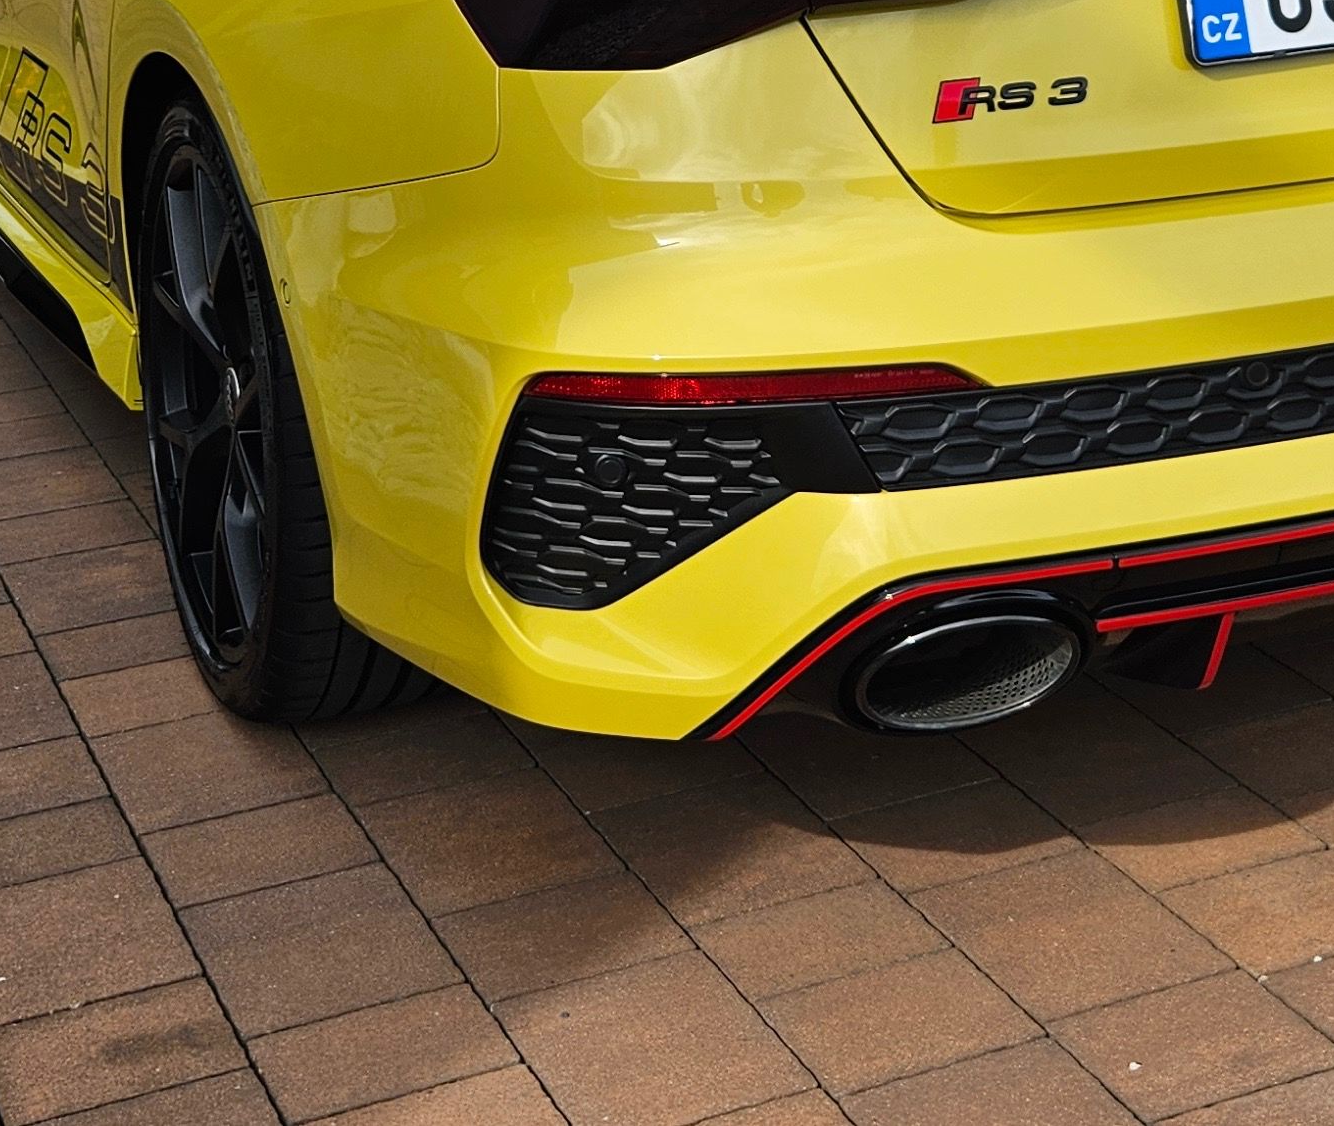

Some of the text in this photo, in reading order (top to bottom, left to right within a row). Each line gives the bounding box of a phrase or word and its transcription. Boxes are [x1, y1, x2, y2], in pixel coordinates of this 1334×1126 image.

[1201, 12, 1243, 44] CZ
[957, 76, 1089, 116] RS 3
